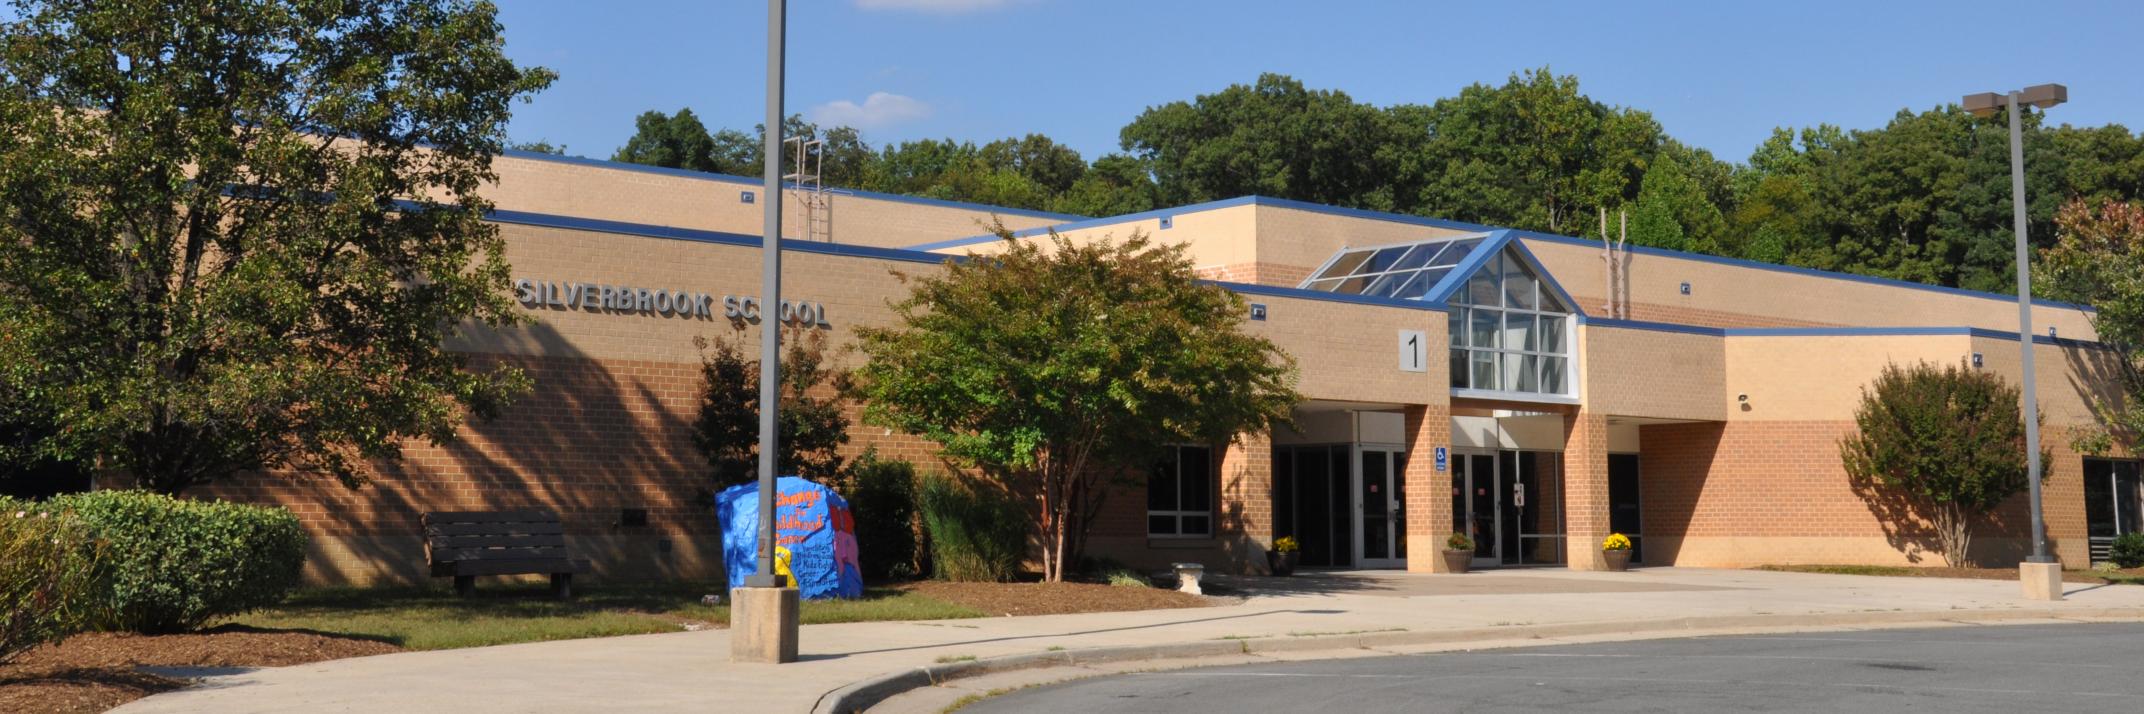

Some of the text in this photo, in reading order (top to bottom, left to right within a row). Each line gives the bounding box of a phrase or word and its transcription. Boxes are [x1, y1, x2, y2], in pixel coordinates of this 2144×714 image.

[516, 278, 829, 325] SILVERBROOK SCOOL
[1408, 334, 1418, 369] 1
